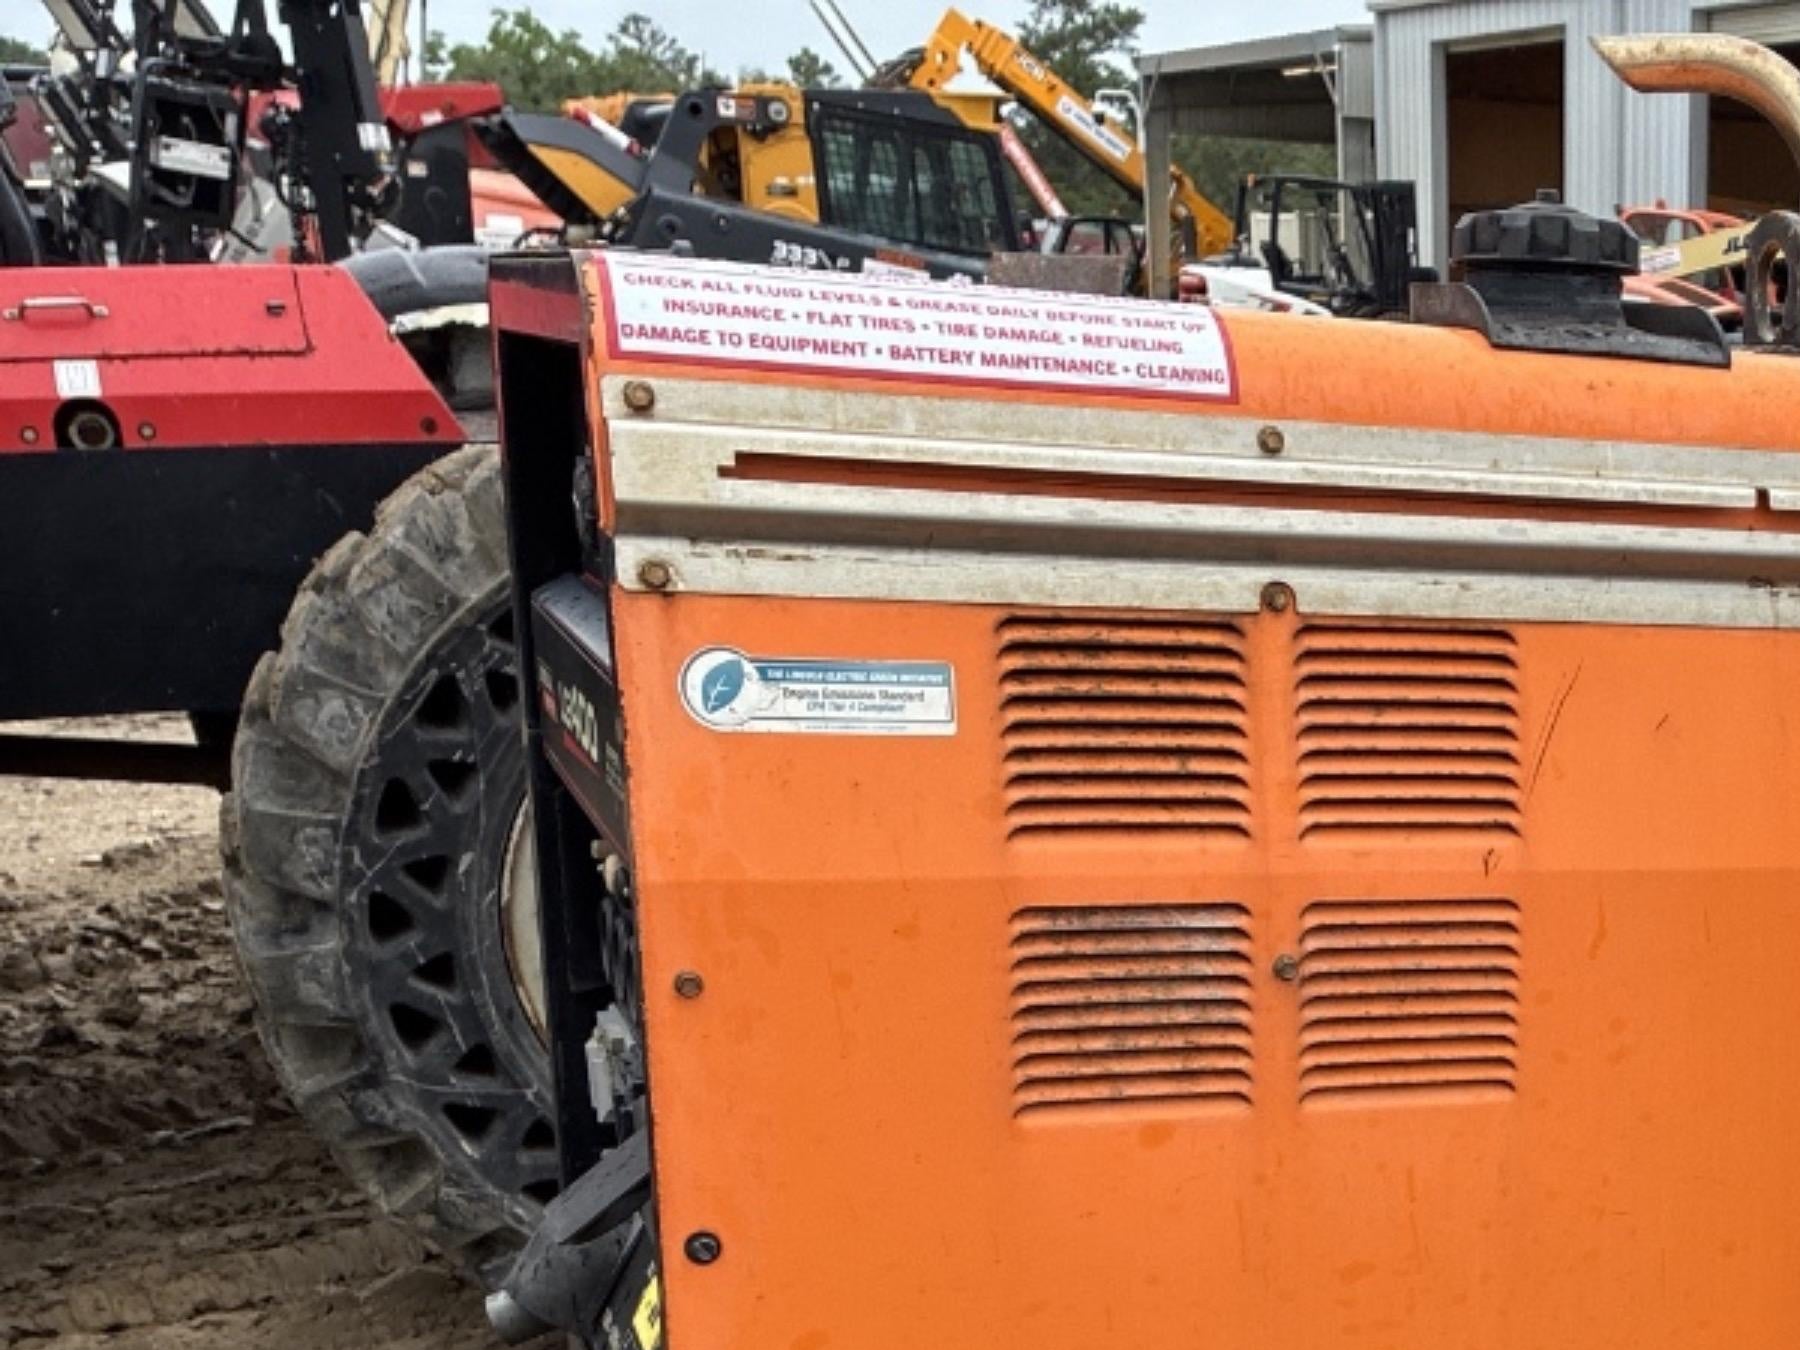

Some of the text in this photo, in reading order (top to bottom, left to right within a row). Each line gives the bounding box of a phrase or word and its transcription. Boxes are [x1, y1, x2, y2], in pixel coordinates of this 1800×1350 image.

[620, 323, 1226, 385] DAMAGE TO EQUIPMENT BATTERY MAINTENANCE CLEANING
[662, 299, 1185, 356] INSURANCE FLAT TIRES TIRE DAMAGE REFUELING
